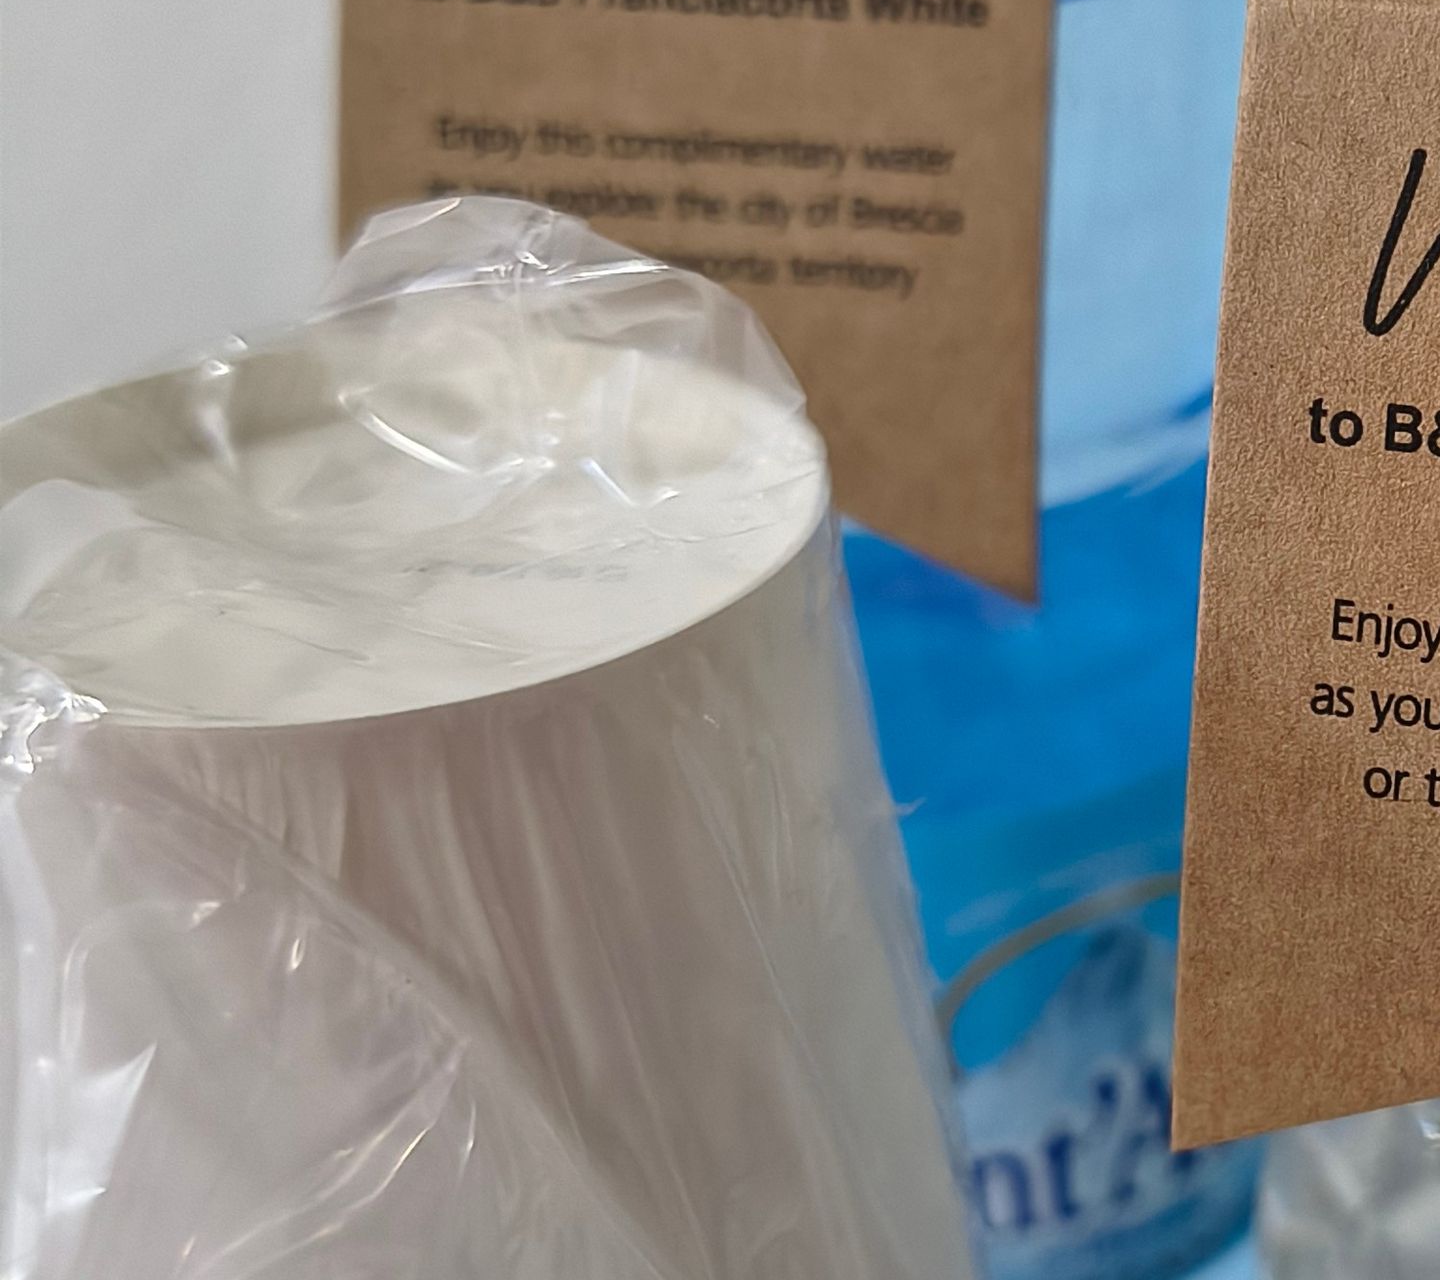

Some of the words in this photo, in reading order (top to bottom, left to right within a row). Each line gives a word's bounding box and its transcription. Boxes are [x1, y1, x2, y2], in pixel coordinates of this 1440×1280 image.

[1307, 397, 1364, 448] to
[1309, 682, 1356, 719] as
[1363, 766, 1411, 802] or
